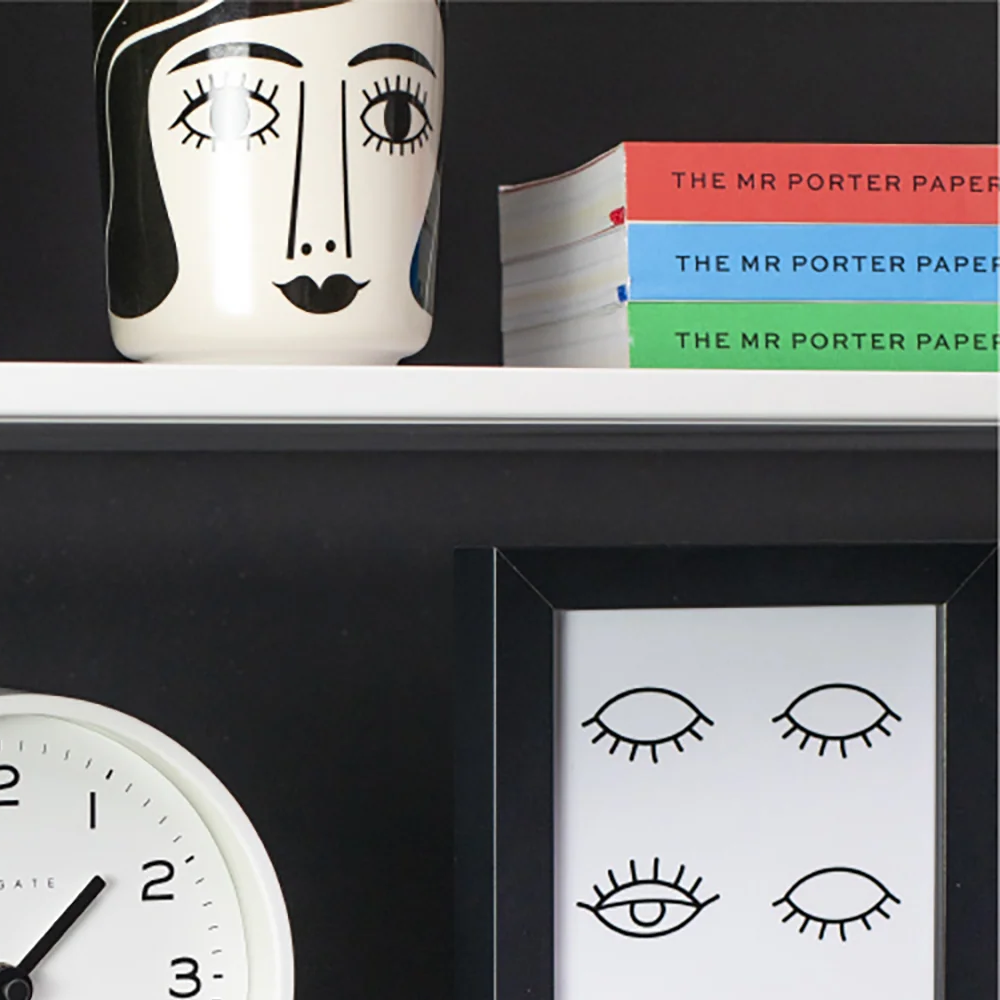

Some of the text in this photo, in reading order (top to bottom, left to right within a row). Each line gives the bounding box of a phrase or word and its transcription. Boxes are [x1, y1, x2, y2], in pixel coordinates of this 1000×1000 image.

[671, 171, 726, 190] THE
[737, 172, 776, 191] MR
[788, 173, 901, 192] PORTER
[675, 255, 730, 272] THE
[741, 255, 781, 272] MR
[792, 255, 905, 273] PORTER
[675, 332, 730, 349] THE
[741, 332, 780, 349] MR
[792, 332, 905, 350] PORTER
[88, 791, 96, 830] 1
[141, 859, 175, 902] 2
[169, 957, 202, 999] 3
